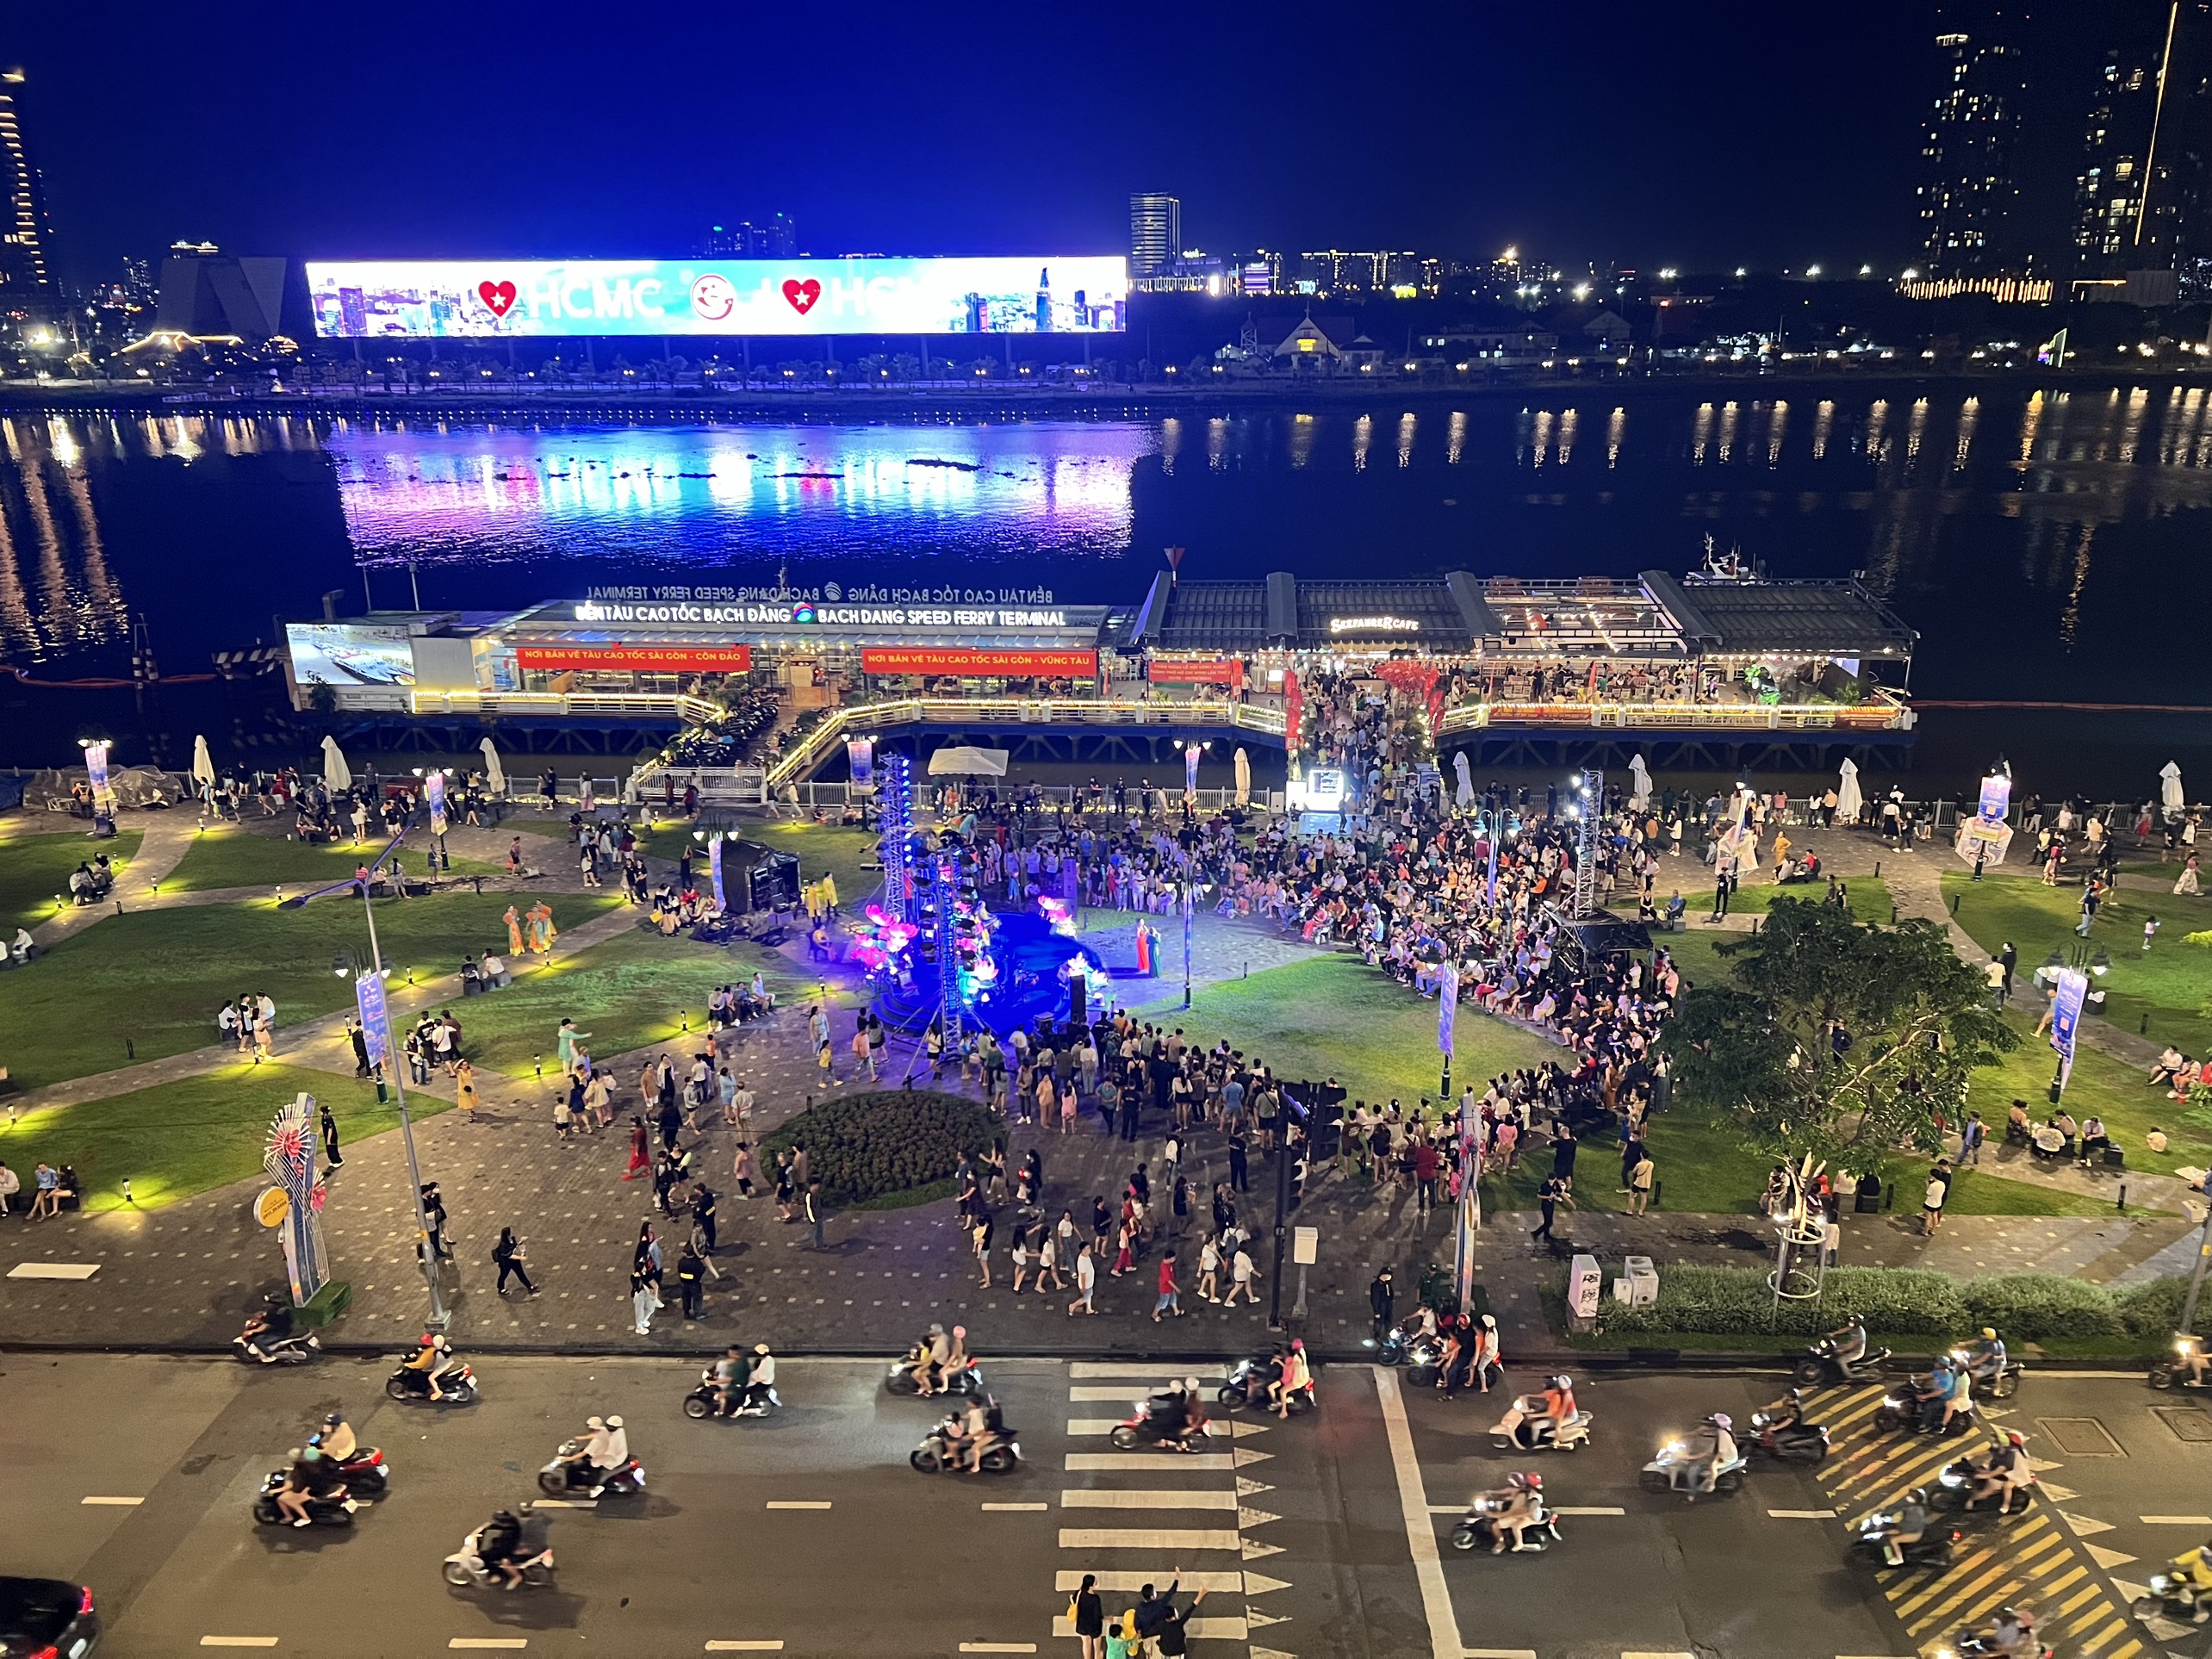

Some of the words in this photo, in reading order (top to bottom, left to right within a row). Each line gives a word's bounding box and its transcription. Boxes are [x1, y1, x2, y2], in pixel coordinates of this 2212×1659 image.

[527, 277, 665, 318] HCMC
[604, 605, 634, 621] TÀU
[636, 607, 670, 621] CAO
[670, 602, 701, 622] TỐC
[703, 607, 744, 624] BẠCH
[817, 609, 860, 624] BACH
[861, 610, 905, 624] DANG
[907, 610, 952, 625] SPEED
[954, 610, 995, 625] FERRY
[997, 611, 1066, 626] TERMINAL
[545, 649, 565, 658] BÁN
[568, 649, 581, 659] VÉ
[582, 649, 601, 659] TÀU
[604, 651, 624, 660] CAO
[626, 650, 646, 660] TỐC
[648, 650, 664, 660] SÀI
[666, 651, 687, 661] GÒN
[695, 651, 717, 661] CÔN
[888, 654, 909, 663] BÁN
[911, 654, 924, 663] VÉ
[926, 654, 945, 663] TÀU
[948, 656, 969, 664] CAO
[971, 655, 991, 664] TỐC
[991, 655, 1008, 664] SÀI
[1010, 655, 1032, 664] GÒN
[1040, 656, 1067, 665] VŨNG
[1070, 656, 1090, 665] TÀU
